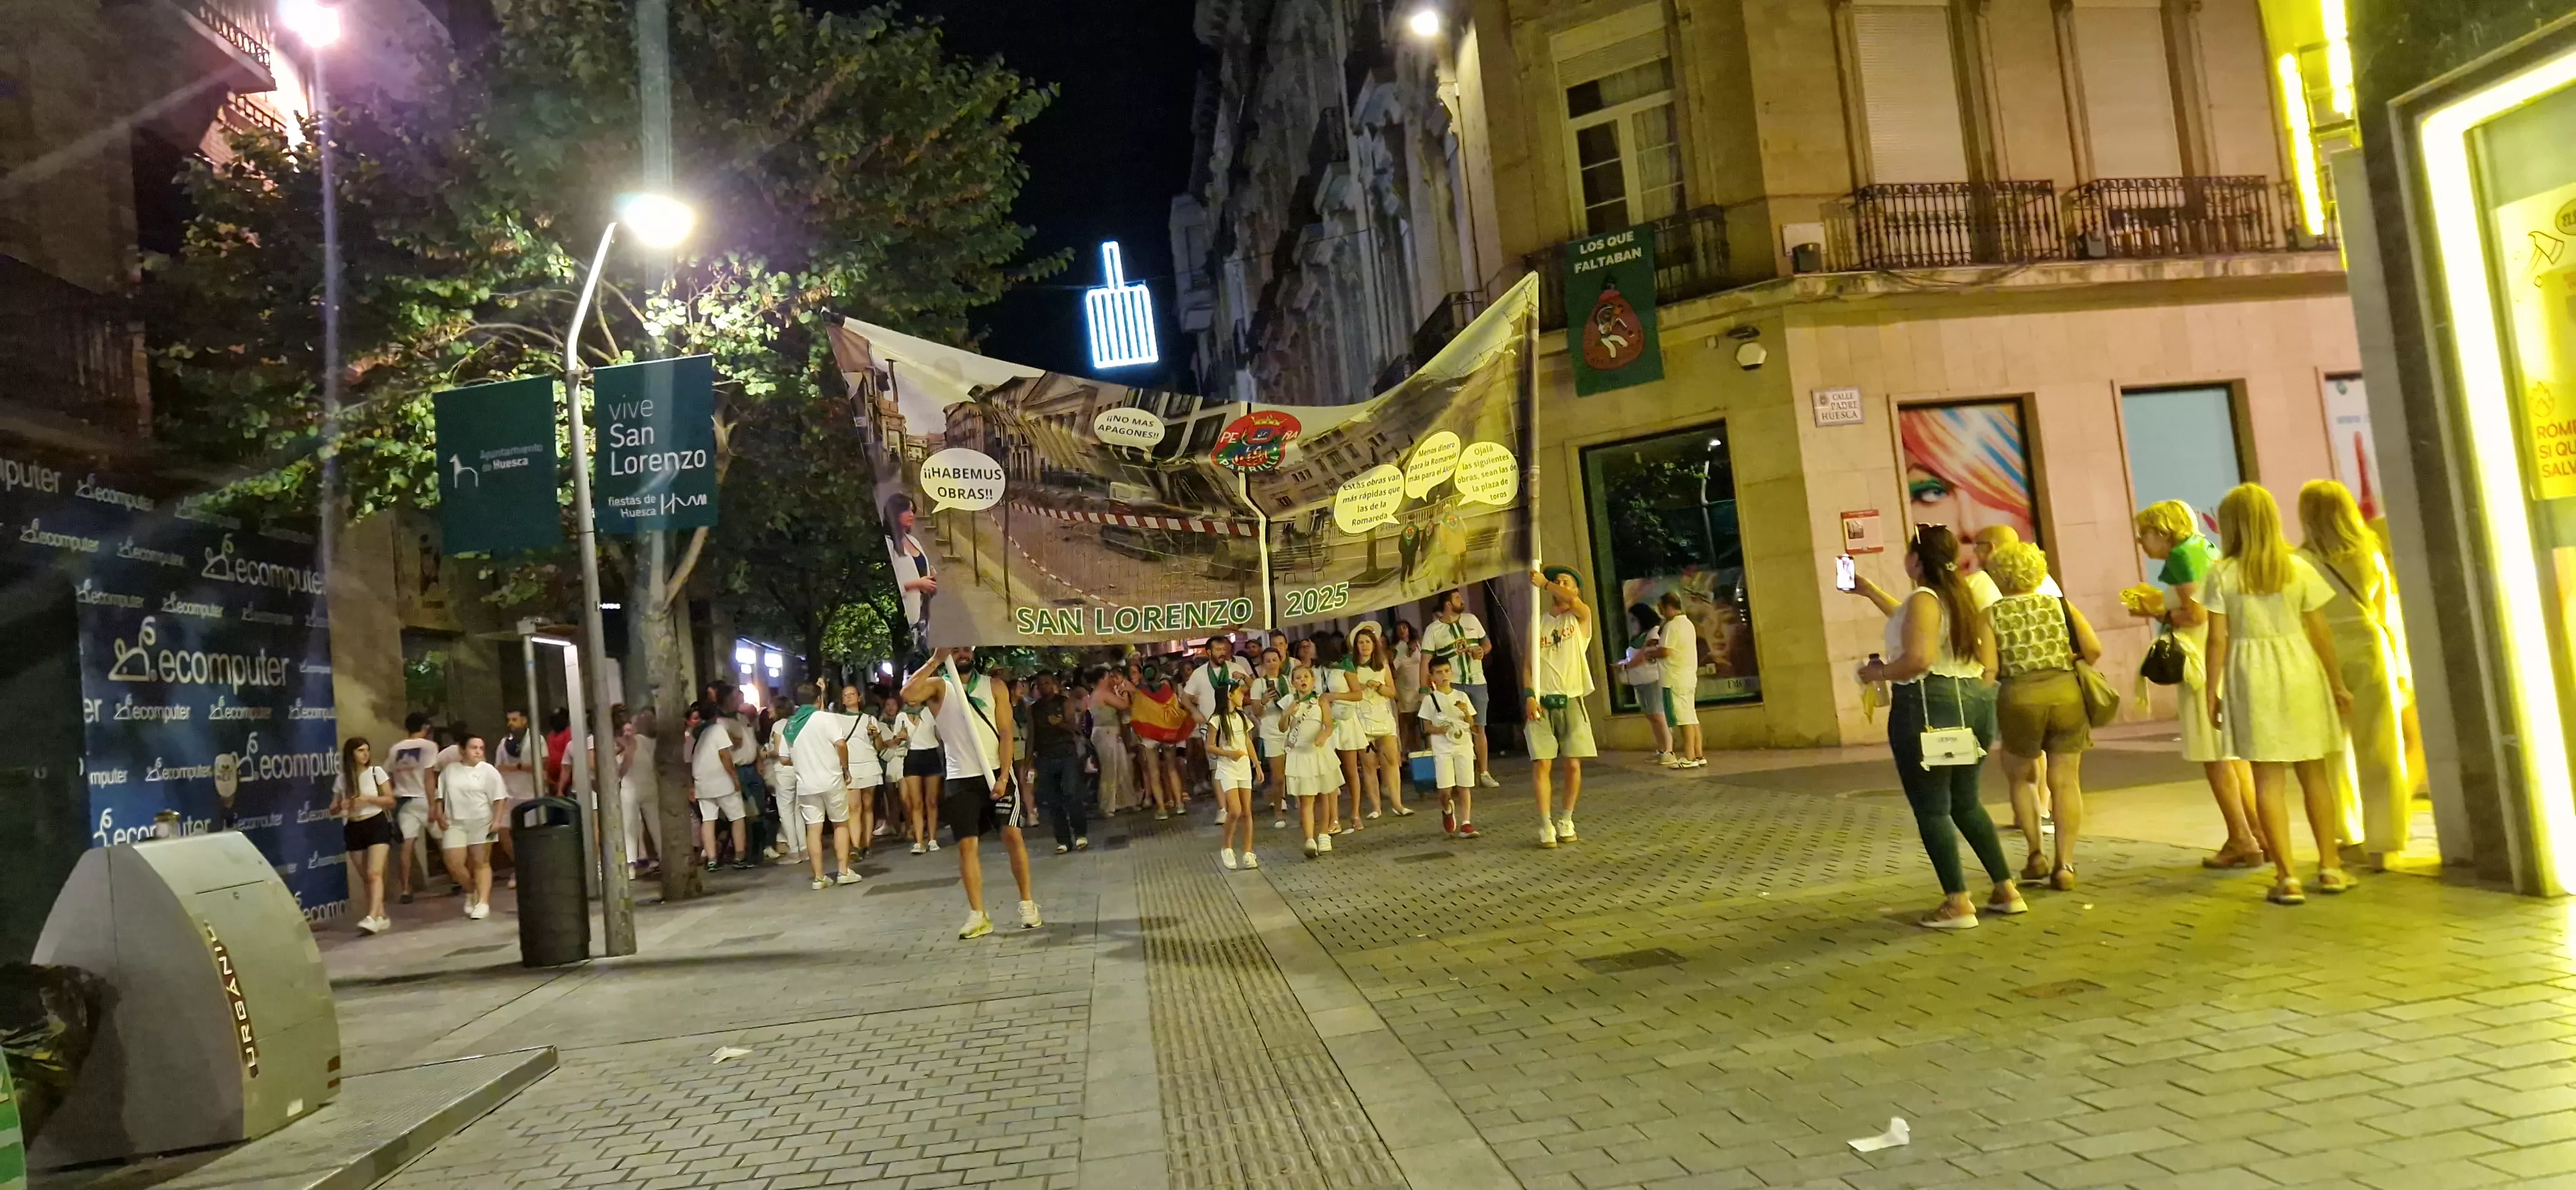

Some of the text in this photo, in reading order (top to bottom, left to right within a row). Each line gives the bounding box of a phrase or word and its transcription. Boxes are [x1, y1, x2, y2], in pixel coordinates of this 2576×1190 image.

[1579, 231, 1634, 254] LOS QUE
[1574, 247, 1642, 274] FALTABAN
[609, 395, 654, 420] vive
[1831, 401, 1858, 410] PADRE
[1822, 410, 1859, 420] HUESCA
[1132, 419, 1154, 427] MAS
[609, 423, 654, 448] San
[1097, 424, 1159, 439] APAGONES!!
[1418, 442, 1455, 457] Menos dinero
[1474, 444, 1493, 457] Ojalá
[2539, 443, 2552, 458] SI
[493, 458, 529, 470] Huesca
[609, 449, 706, 476] Lorenzo
[1219, 455, 1280, 473] PARRILLA
[1473, 454, 1510, 468] siguientes
[923, 467, 1002, 480] ¡¡HABEMUS
[1410, 463, 1423, 473] para
[1367, 477, 1386, 487] obras
[1408, 475, 1420, 483] más
[1421, 471, 1435, 481] para
[1457, 474, 1479, 484] obras,
[1481, 469, 1498, 478] sean
[1481, 480, 1499, 493] plaza
[938, 487, 993, 500] OBRAS!!
[1343, 486, 1400, 504] más rápidas que
[1490, 491, 1507, 500] toros
[608, 496, 642, 506] fiestas
[644, 495, 656, 504] de
[621, 508, 656, 518] Huesca
[1352, 513, 1388, 526] Romareda
[1016, 581, 1350, 636] SAN LORENZO 2025
[158, 648, 290, 694] ecomputer
[132, 704, 191, 724] ecomputer
